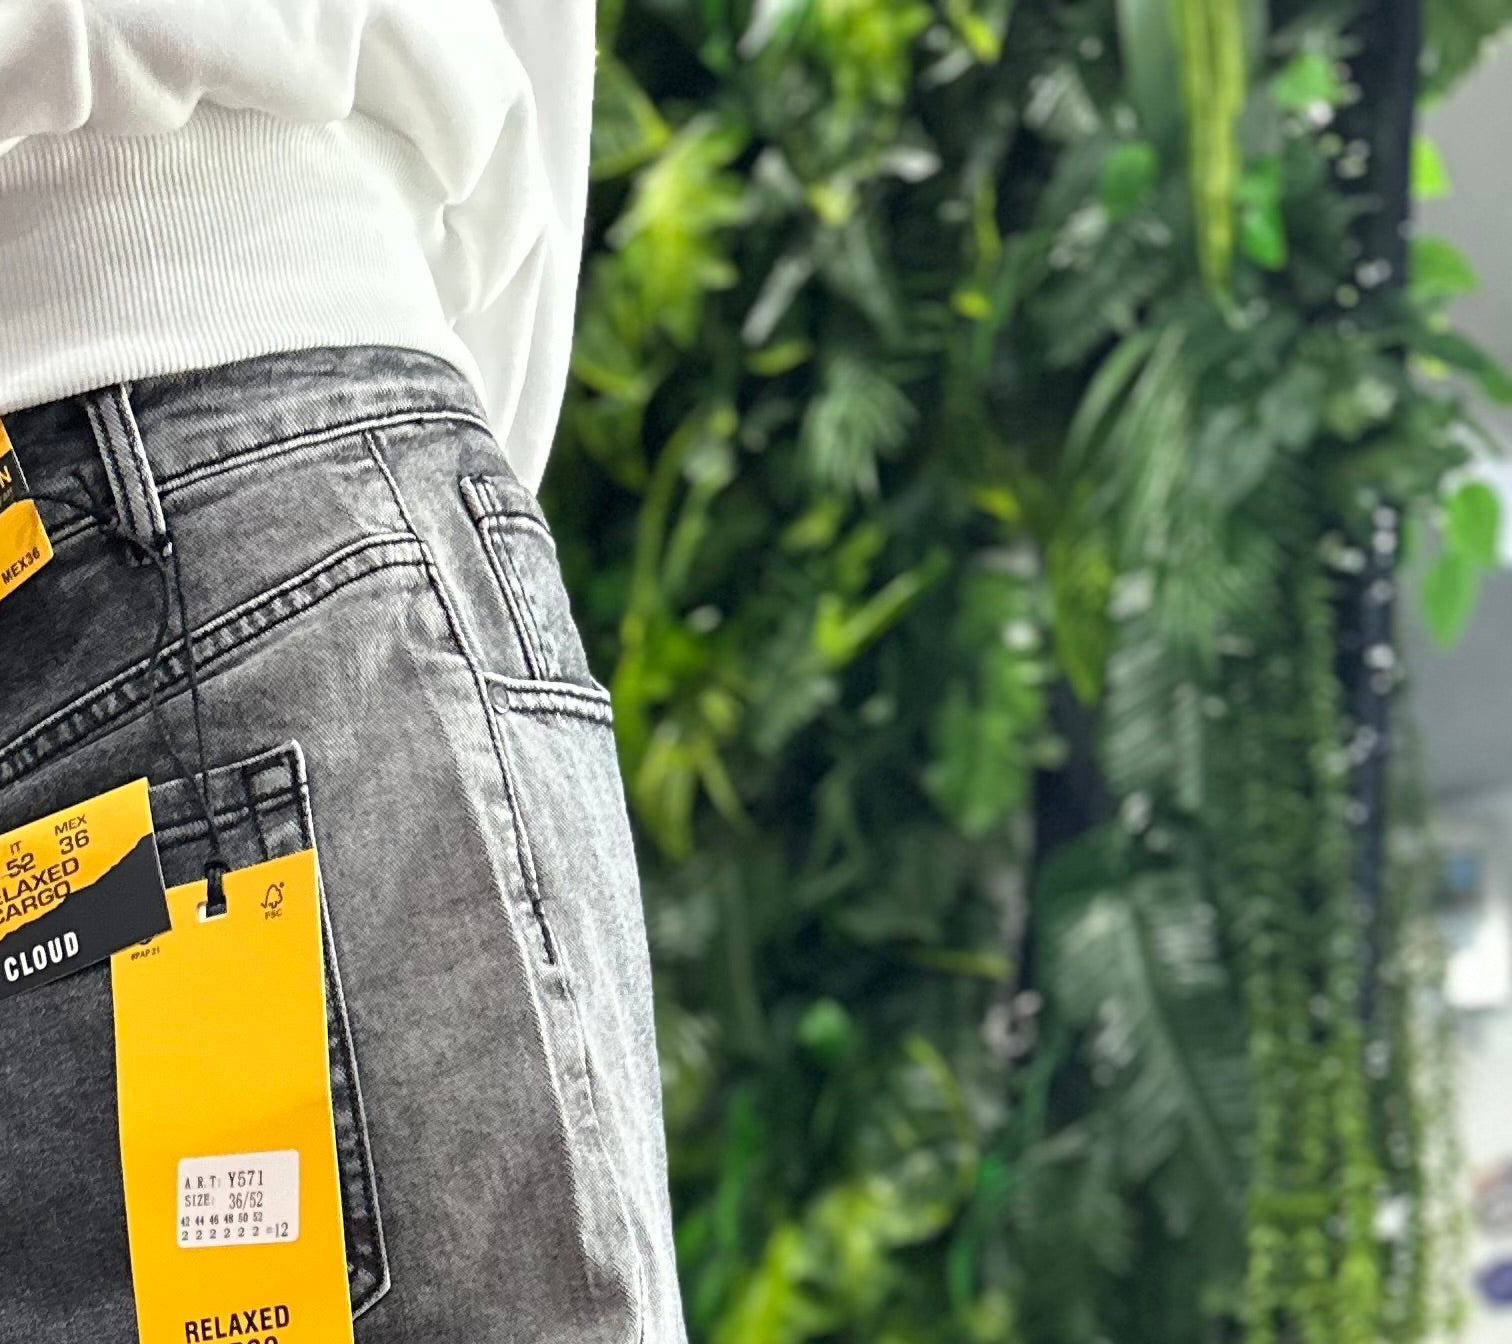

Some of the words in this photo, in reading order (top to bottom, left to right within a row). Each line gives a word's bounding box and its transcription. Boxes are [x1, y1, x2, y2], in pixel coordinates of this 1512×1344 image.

[1, 547, 41, 585] MEX36
[6, 852, 36, 879] 52
[58, 829, 89, 856] 36
[9, 840, 22, 855] IT
[54, 814, 88, 836] MEX
[3, 931, 80, 983] CLOUD
[228, 1170, 263, 1188] Y571
[195, 1216, 204, 1226] 44
[209, 1214, 219, 1225] 46
[224, 1213, 234, 1224] 48
[253, 1211, 263, 1222] 52
[229, 1191, 263, 1210] 36/52
[185, 1304, 290, 1344] RELAXED
